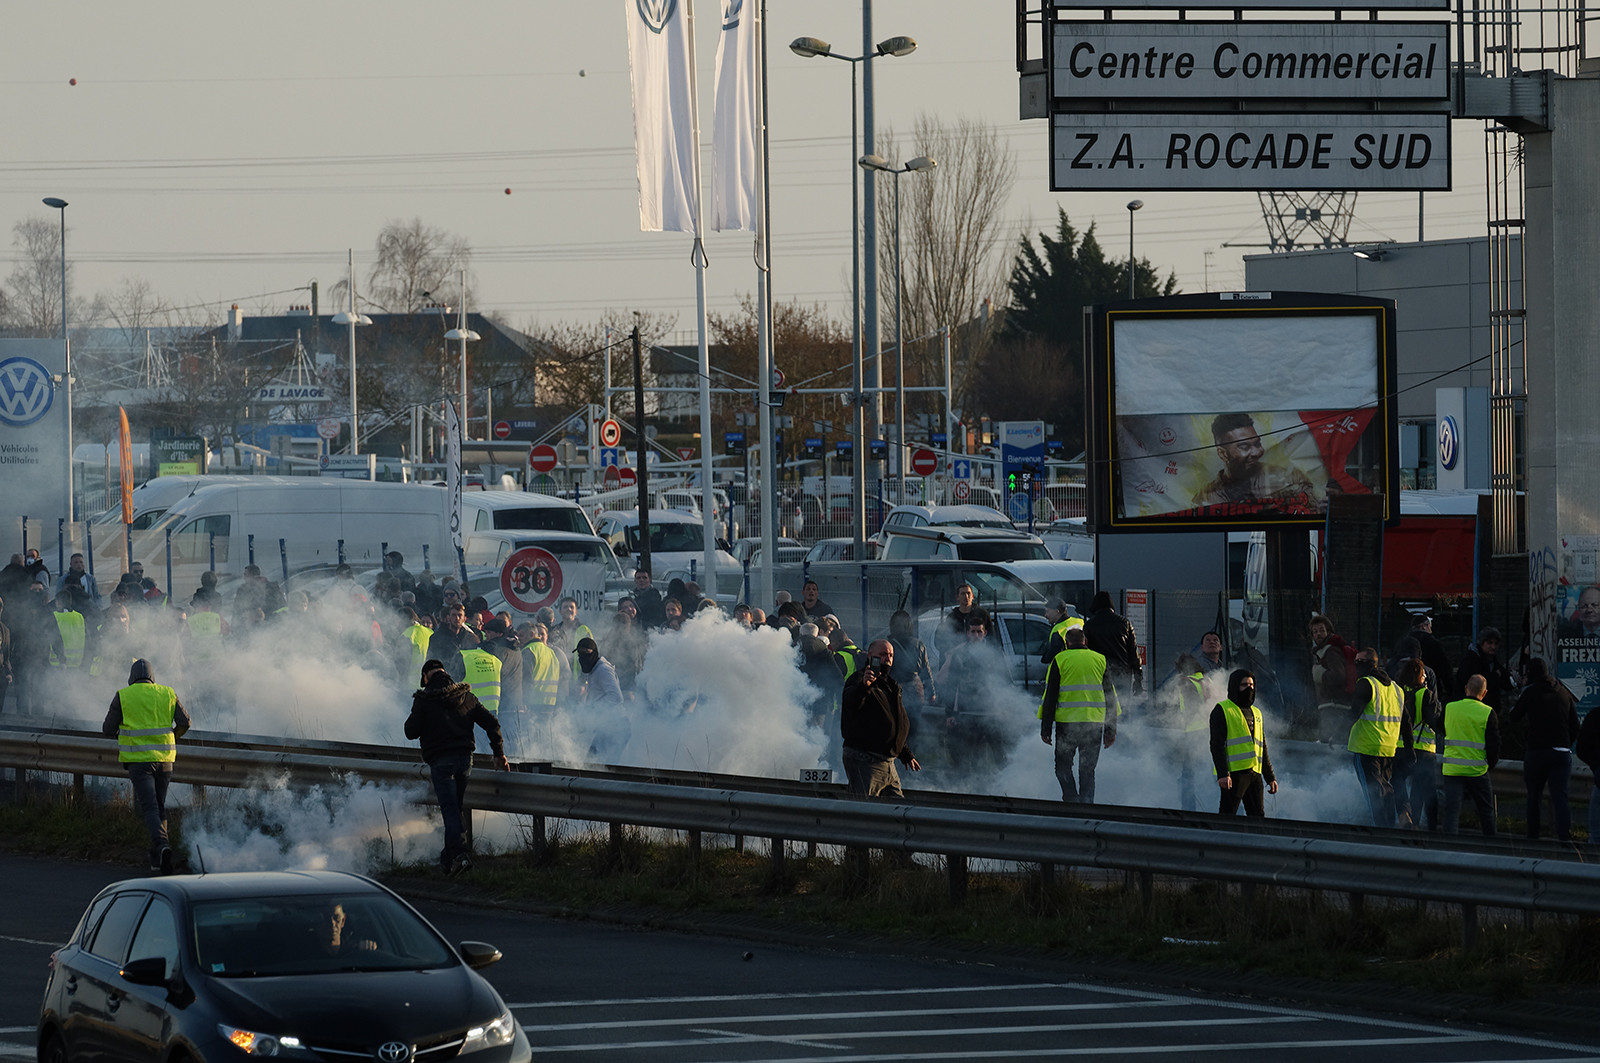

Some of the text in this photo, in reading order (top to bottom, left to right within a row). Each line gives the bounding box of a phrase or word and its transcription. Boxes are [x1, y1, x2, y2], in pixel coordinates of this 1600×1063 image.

[1069, 41, 1437, 80] Centre Commercial
[1070, 131, 1433, 170] Z.A. ROCADE SUD
[260, 388, 276, 398] DE
[280, 388, 325, 398] LAVAGE
[0, 443, 39, 453] Véhicules
[158, 440, 200, 450] Jardinerie
[0, 455, 39, 464] Utilitaires
[1007, 454, 1042, 463] Bienvenue
[1164, 466, 1179, 475] FIRE
[513, 566, 552, 595] 30
[1557, 637, 1600, 647] ASSELINE
[804, 770, 829, 782] 38.2
